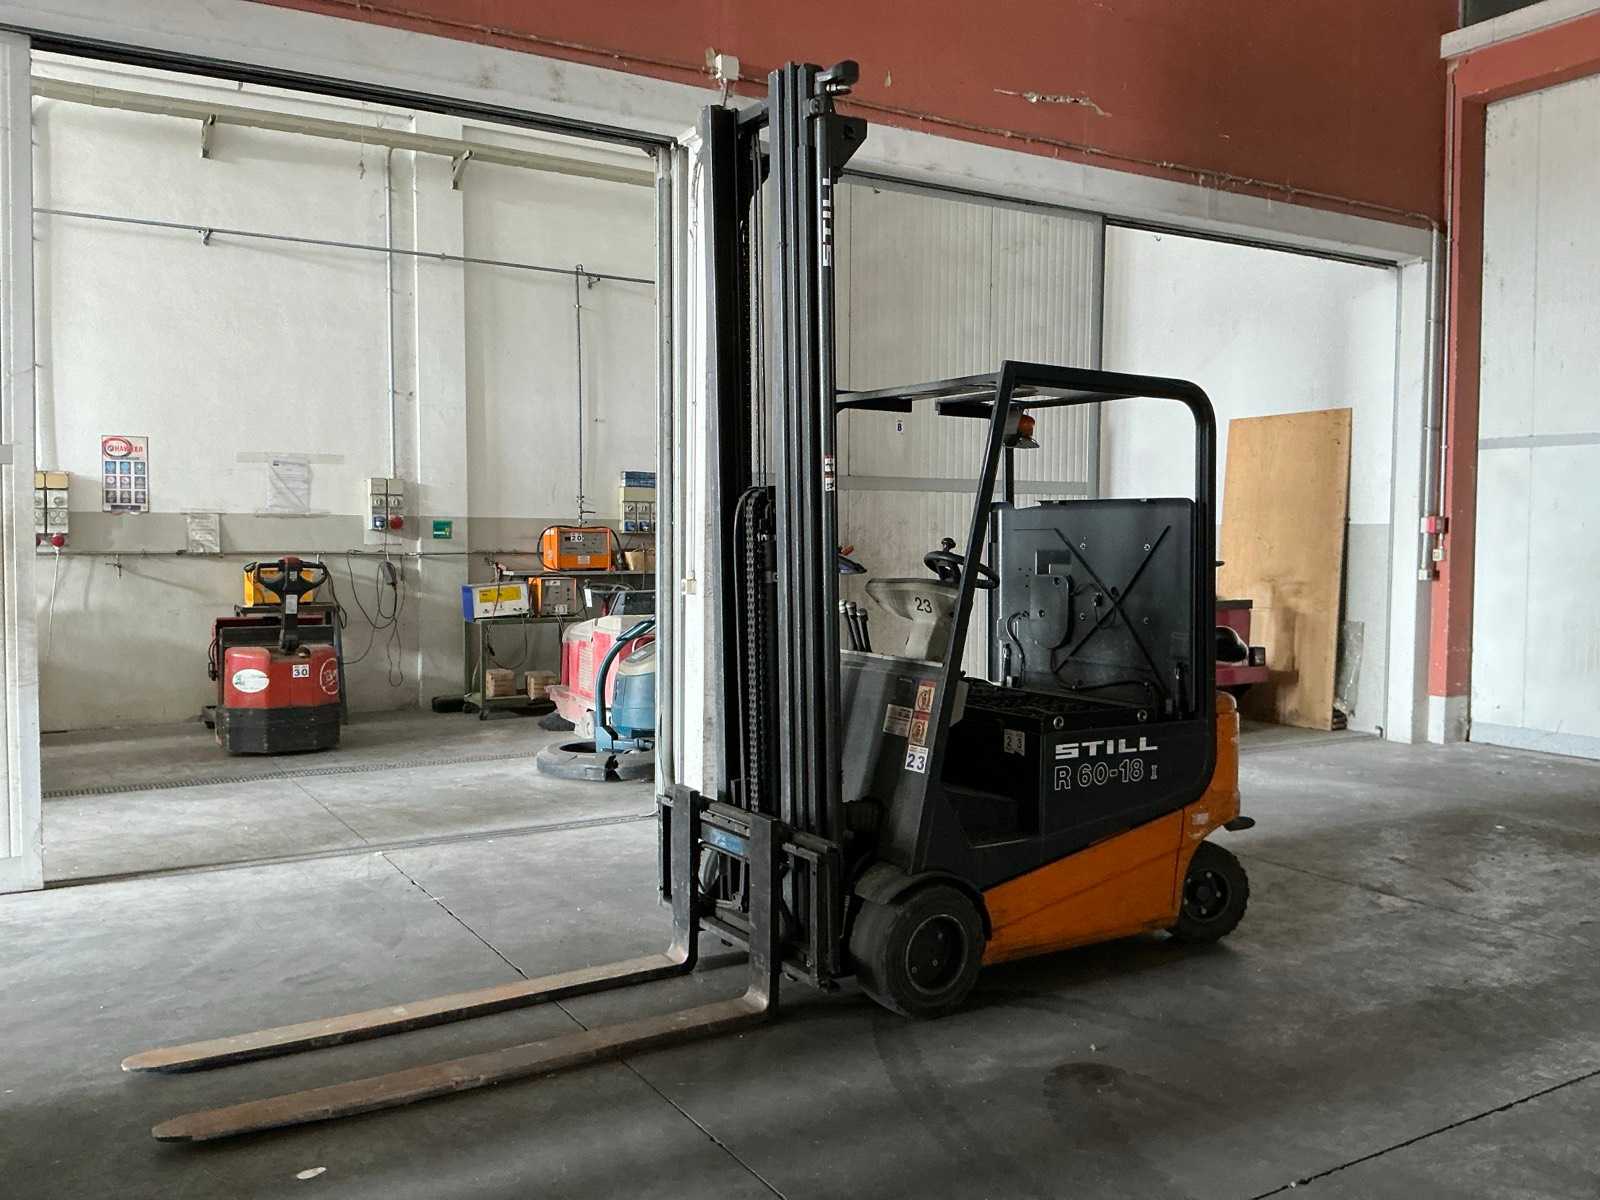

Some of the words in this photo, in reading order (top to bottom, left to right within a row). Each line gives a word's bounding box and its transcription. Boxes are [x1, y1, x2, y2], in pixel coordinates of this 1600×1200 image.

[823, 167, 832, 267] STILL
[914, 597, 932, 613] 23
[294, 668, 308, 676] 30
[1055, 737, 1158, 760] STILL
[906, 753, 926, 771] 23
[1054, 765, 1072, 791] R
[1077, 758, 1144, 788] 60-18
